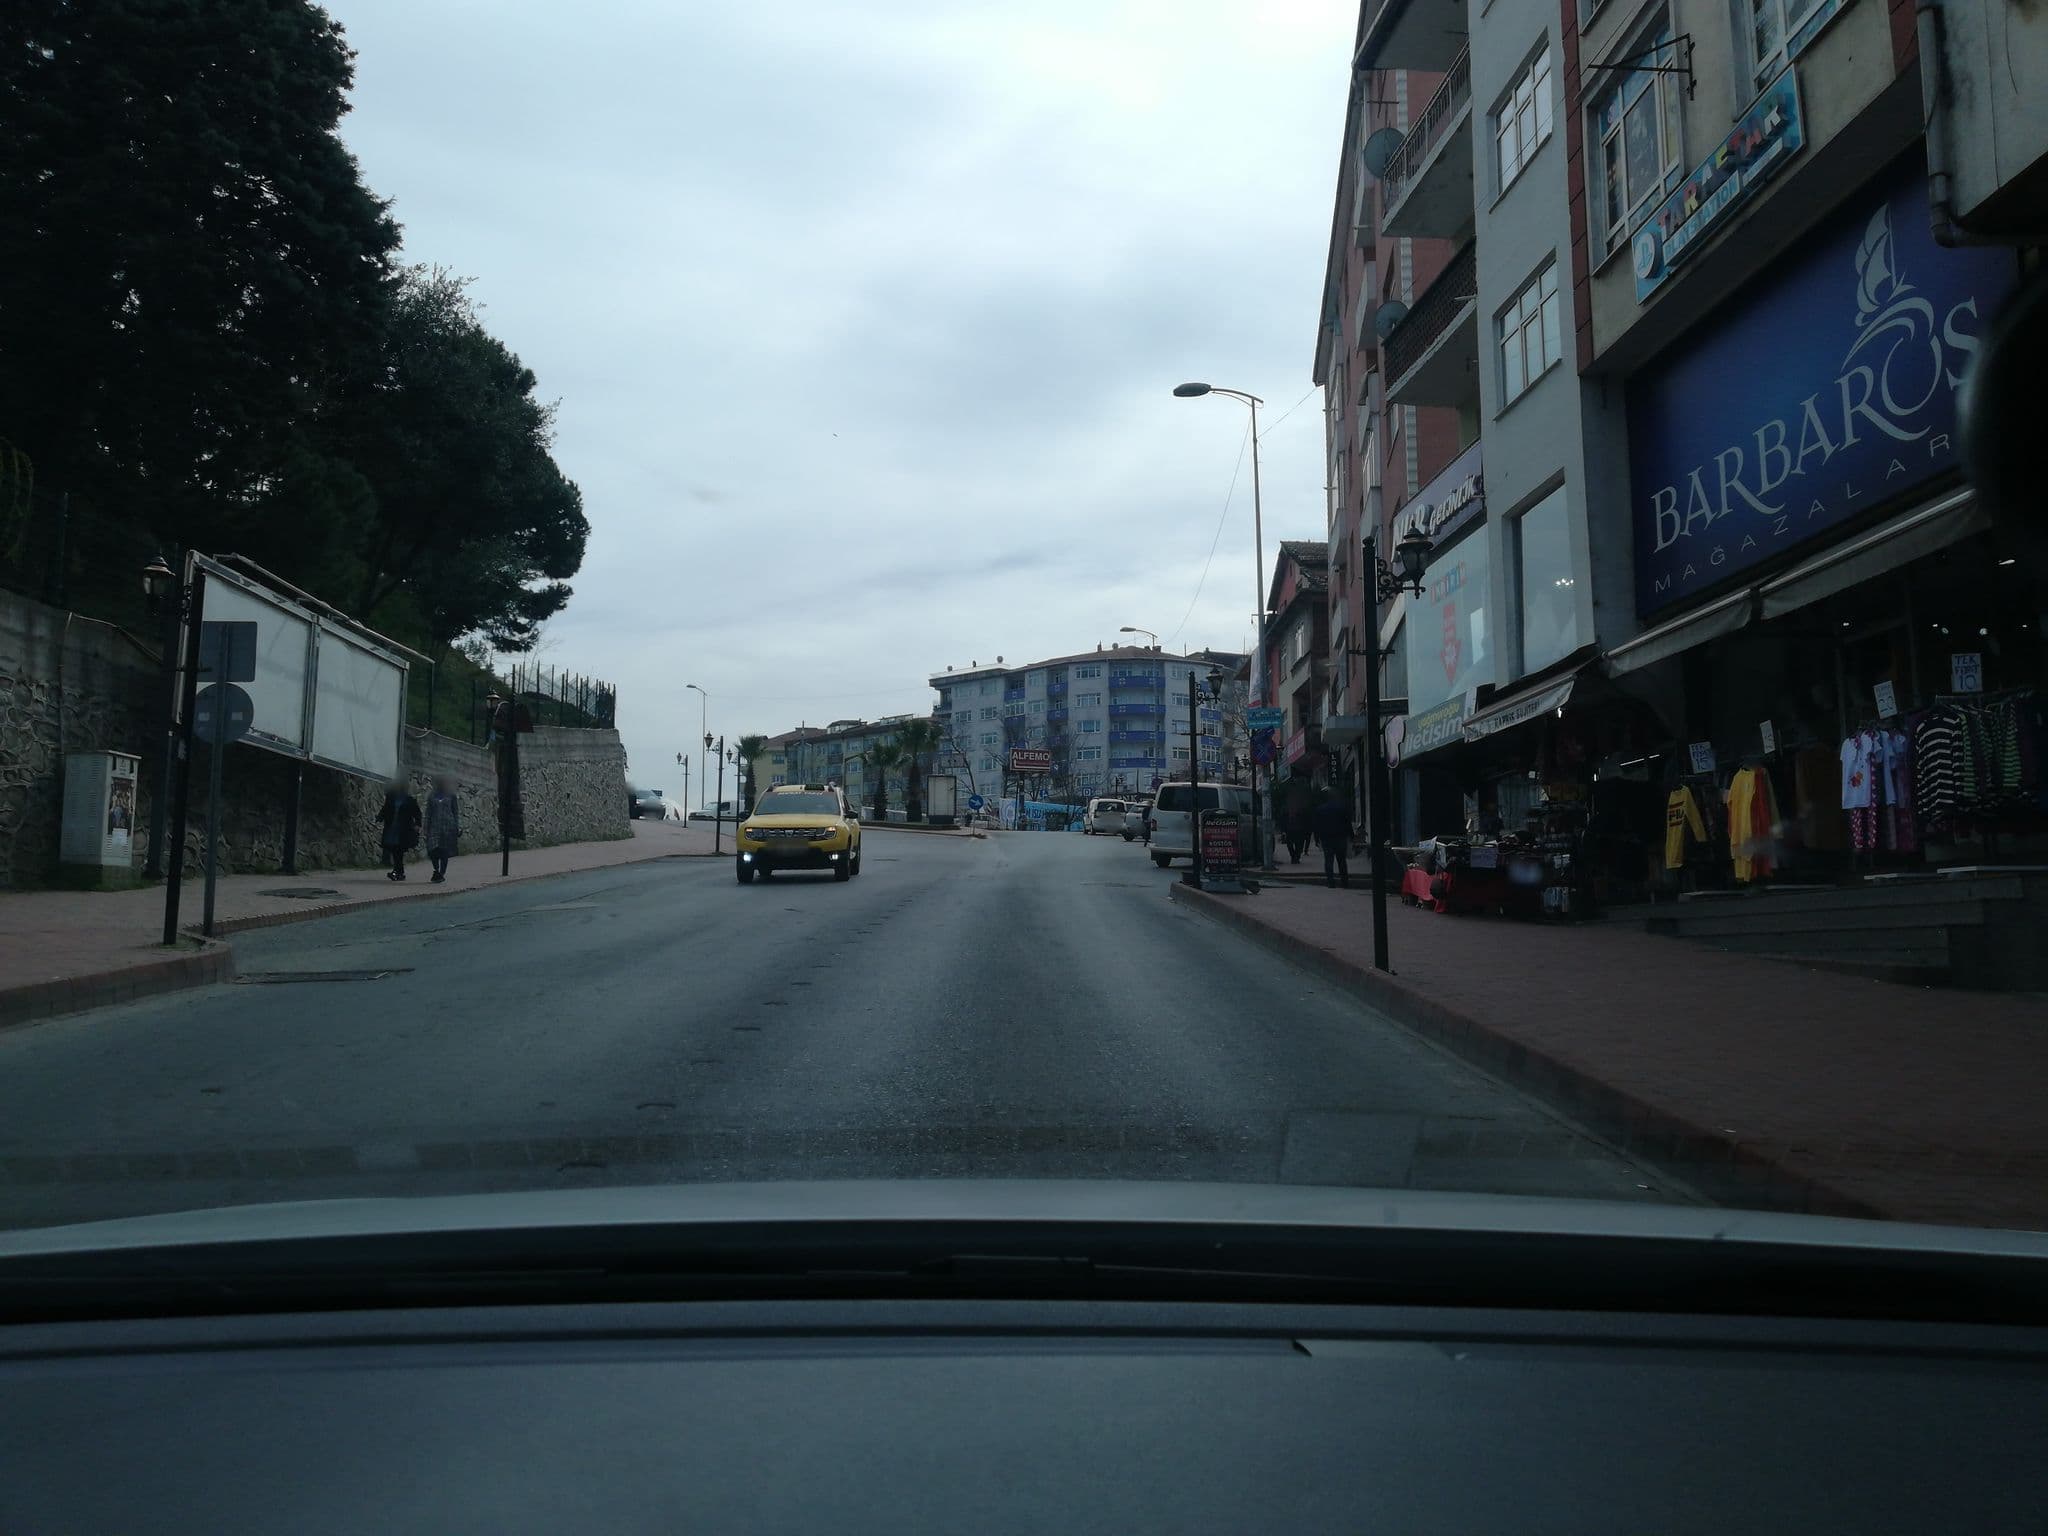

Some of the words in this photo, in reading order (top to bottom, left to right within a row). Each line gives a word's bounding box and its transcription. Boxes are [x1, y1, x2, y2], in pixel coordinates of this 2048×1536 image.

[1650, 295, 1980, 554] BARBAROS
[1960, 674, 1978, 690] 10
[1012, 751, 1050, 762] ALFEMO
